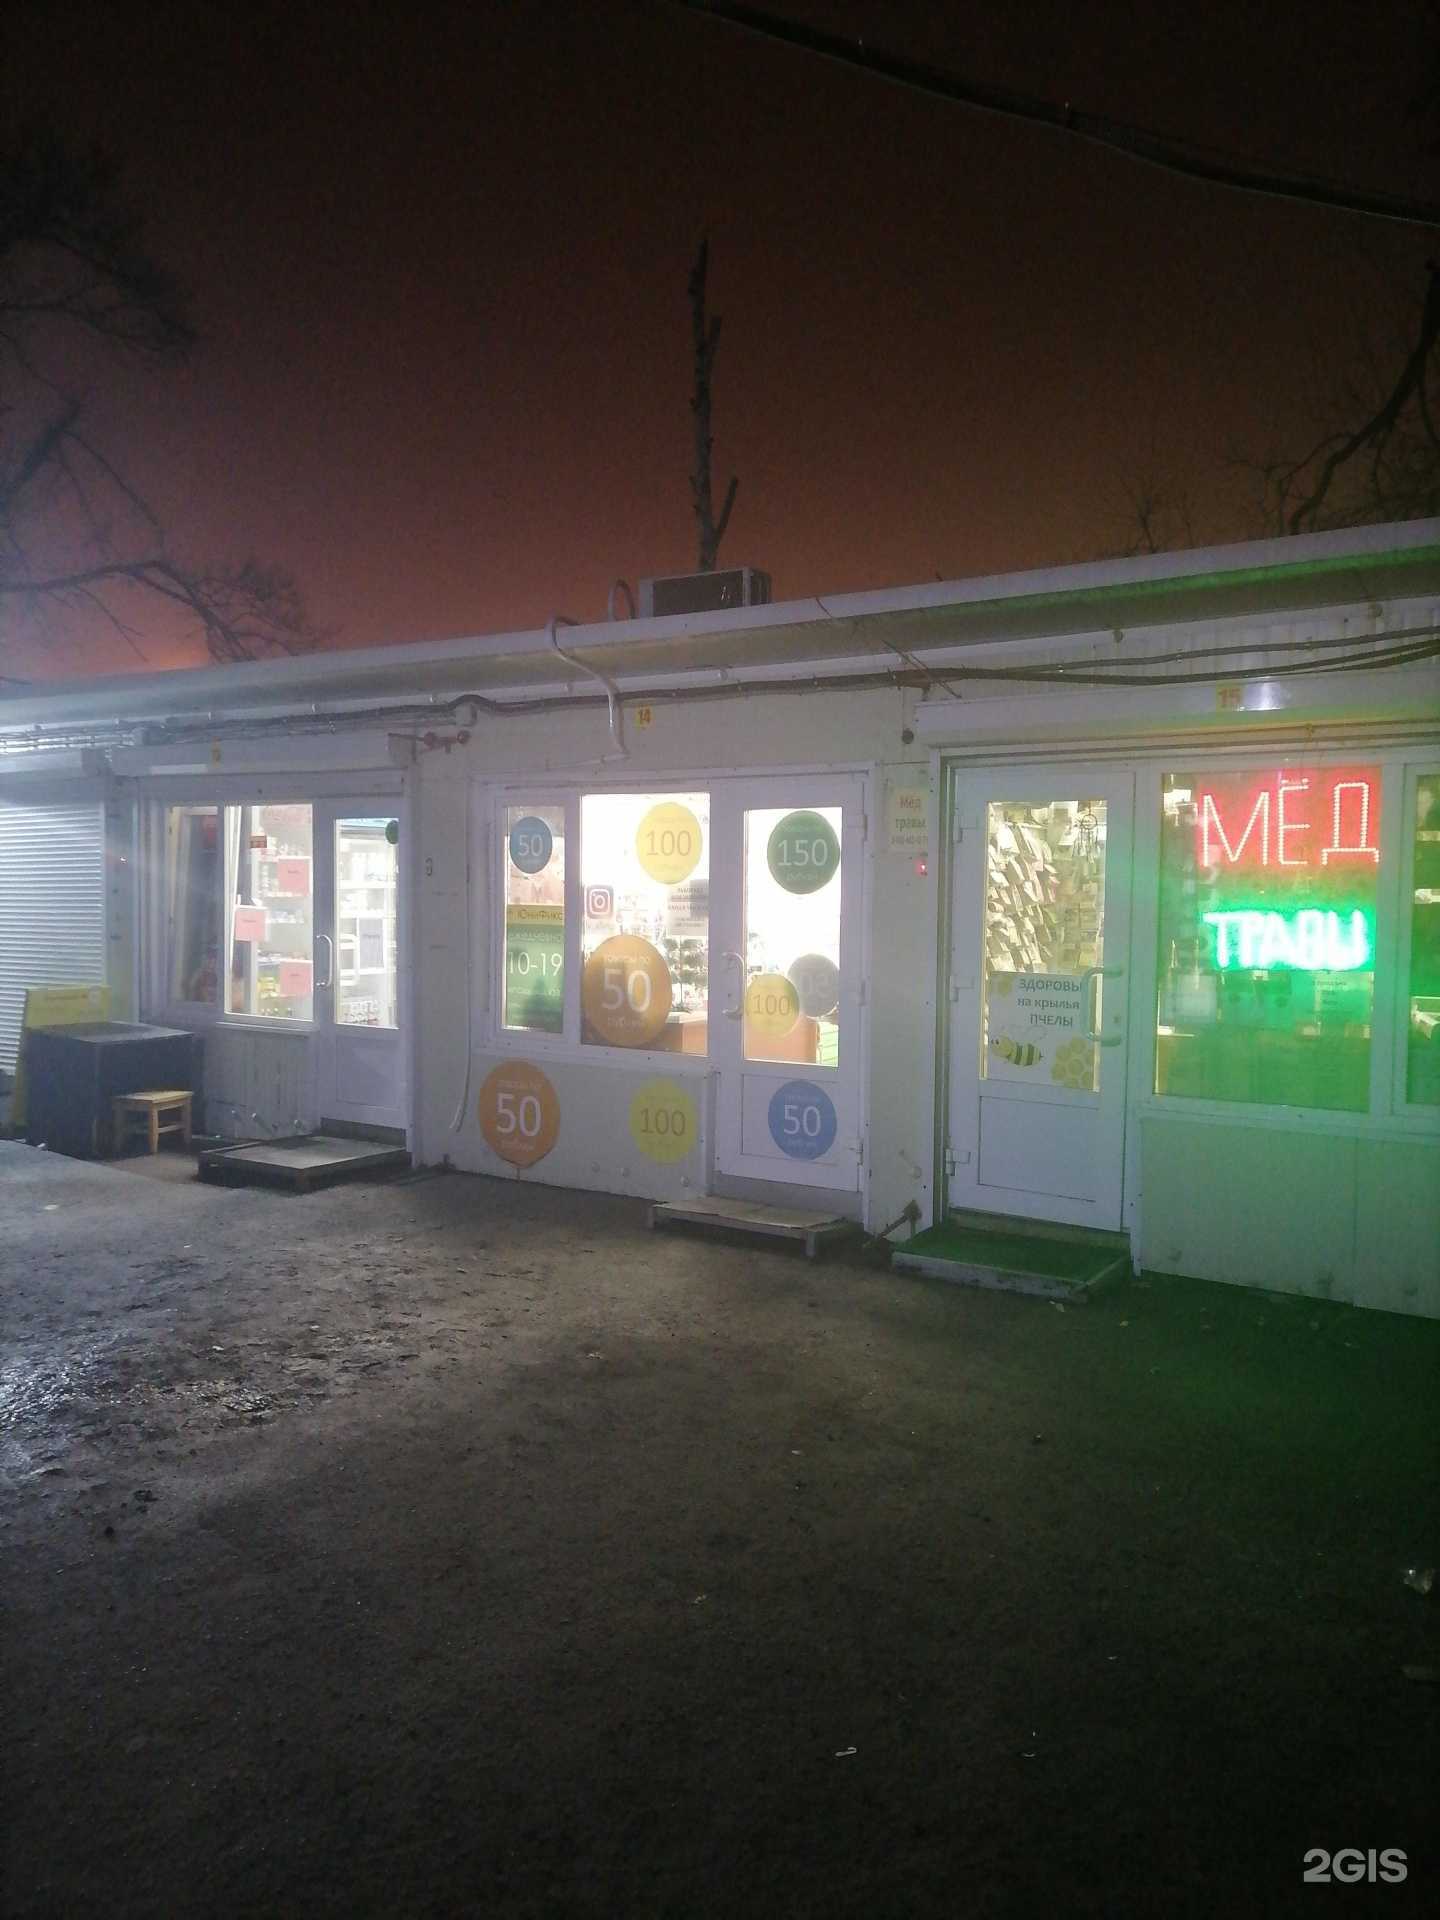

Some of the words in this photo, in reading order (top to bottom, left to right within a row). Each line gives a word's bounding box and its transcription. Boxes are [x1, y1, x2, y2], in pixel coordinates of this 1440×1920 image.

[1203, 778, 1380, 867] МЁД
[517, 834, 543, 857] 50
[645, 829, 692, 857] 100
[777, 838, 828, 867] 150
[1202, 909, 1370, 971] ТРАВЫ
[508, 951, 562, 977] 10-19
[601, 967, 652, 1013] 50
[1018, 979, 1082, 992] ЗДОРОВЬ
[752, 994, 790, 1016] 100
[1035, 1000, 1080, 1010] крылья
[1030, 1013, 1073, 1028] ПЧЕЛЫ
[497, 1092, 541, 1137] 50
[640, 1107, 686, 1137] 100
[784, 1104, 820, 1136] 50
